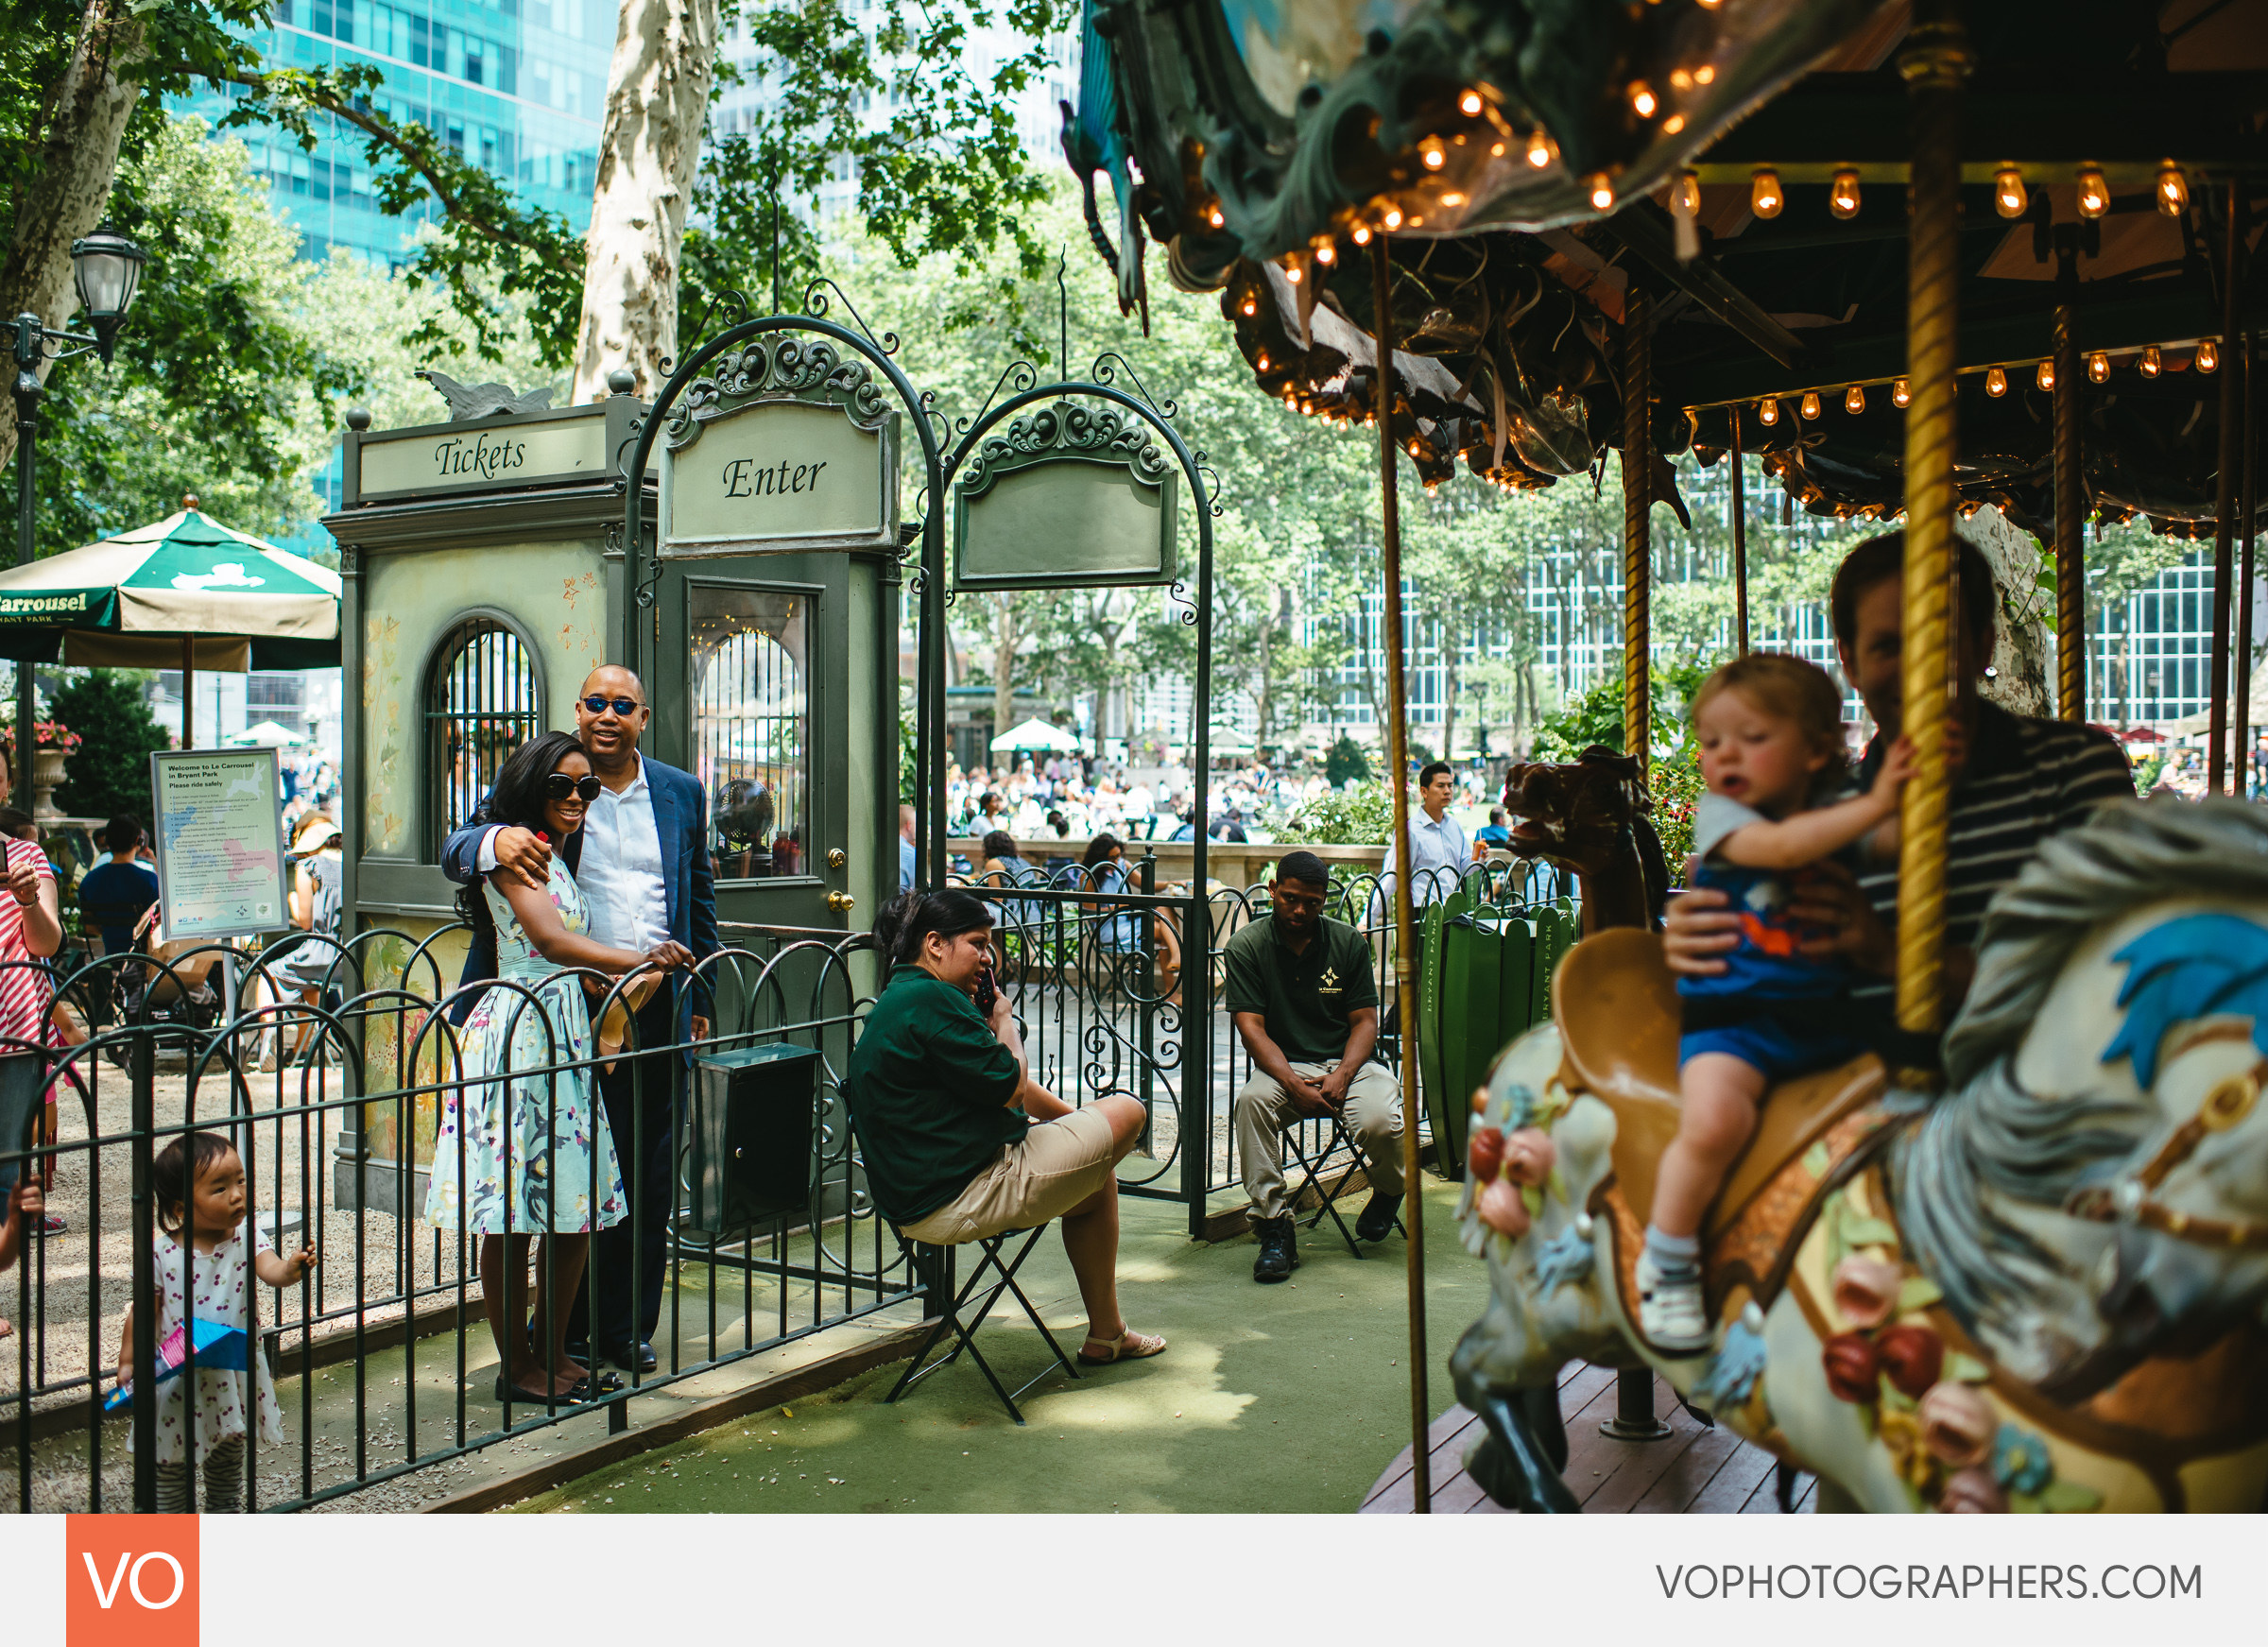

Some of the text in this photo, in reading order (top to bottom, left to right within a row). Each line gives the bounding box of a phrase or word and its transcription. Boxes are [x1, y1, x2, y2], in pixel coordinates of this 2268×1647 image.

[435, 433, 524, 480] Tickets
[722, 458, 828, 499] Enter
[0, 592, 87, 612] arrousel
[1542, 967, 1551, 1021] BRYANT
